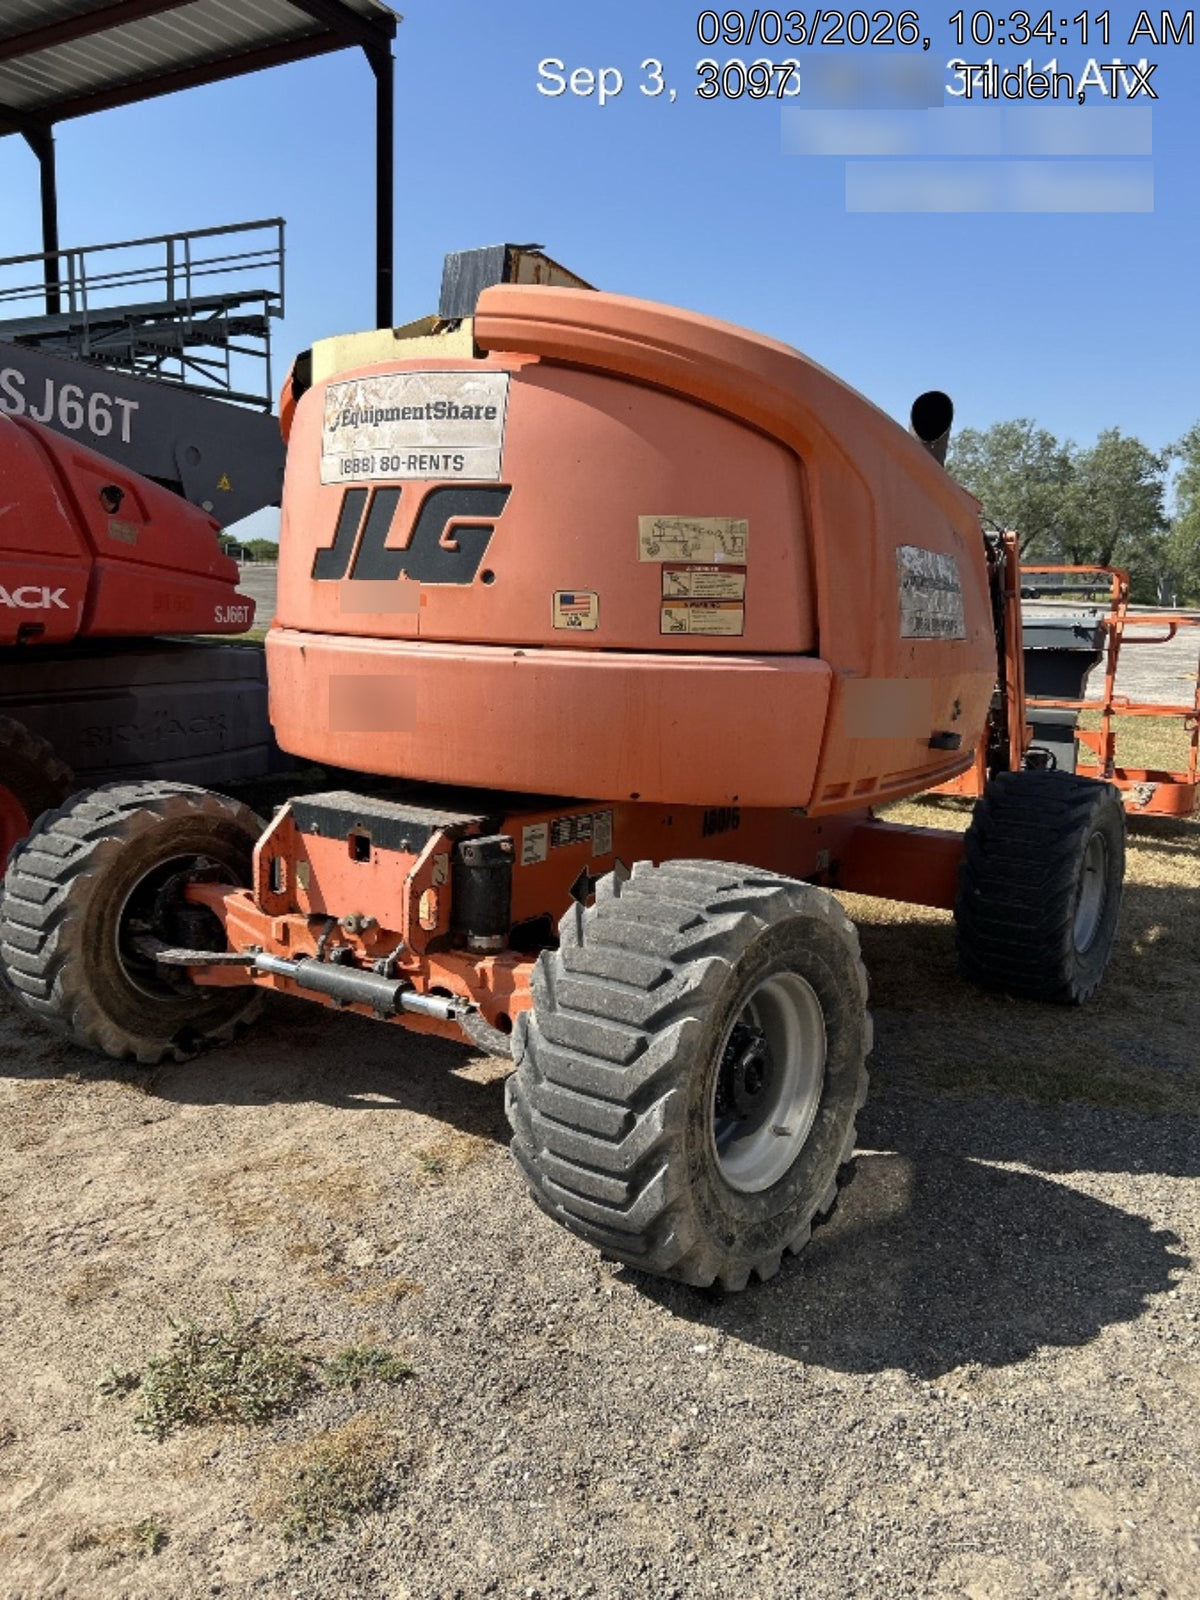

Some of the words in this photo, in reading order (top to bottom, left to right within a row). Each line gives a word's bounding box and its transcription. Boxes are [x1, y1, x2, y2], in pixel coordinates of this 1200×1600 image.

[0, 368, 139, 443] SJ66T
[341, 401, 497, 428] EquipmentShare
[380, 454, 465, 472] 80-RENTS
[311, 485, 513, 586] JLG
[214, 605, 250, 624] SJ66T
